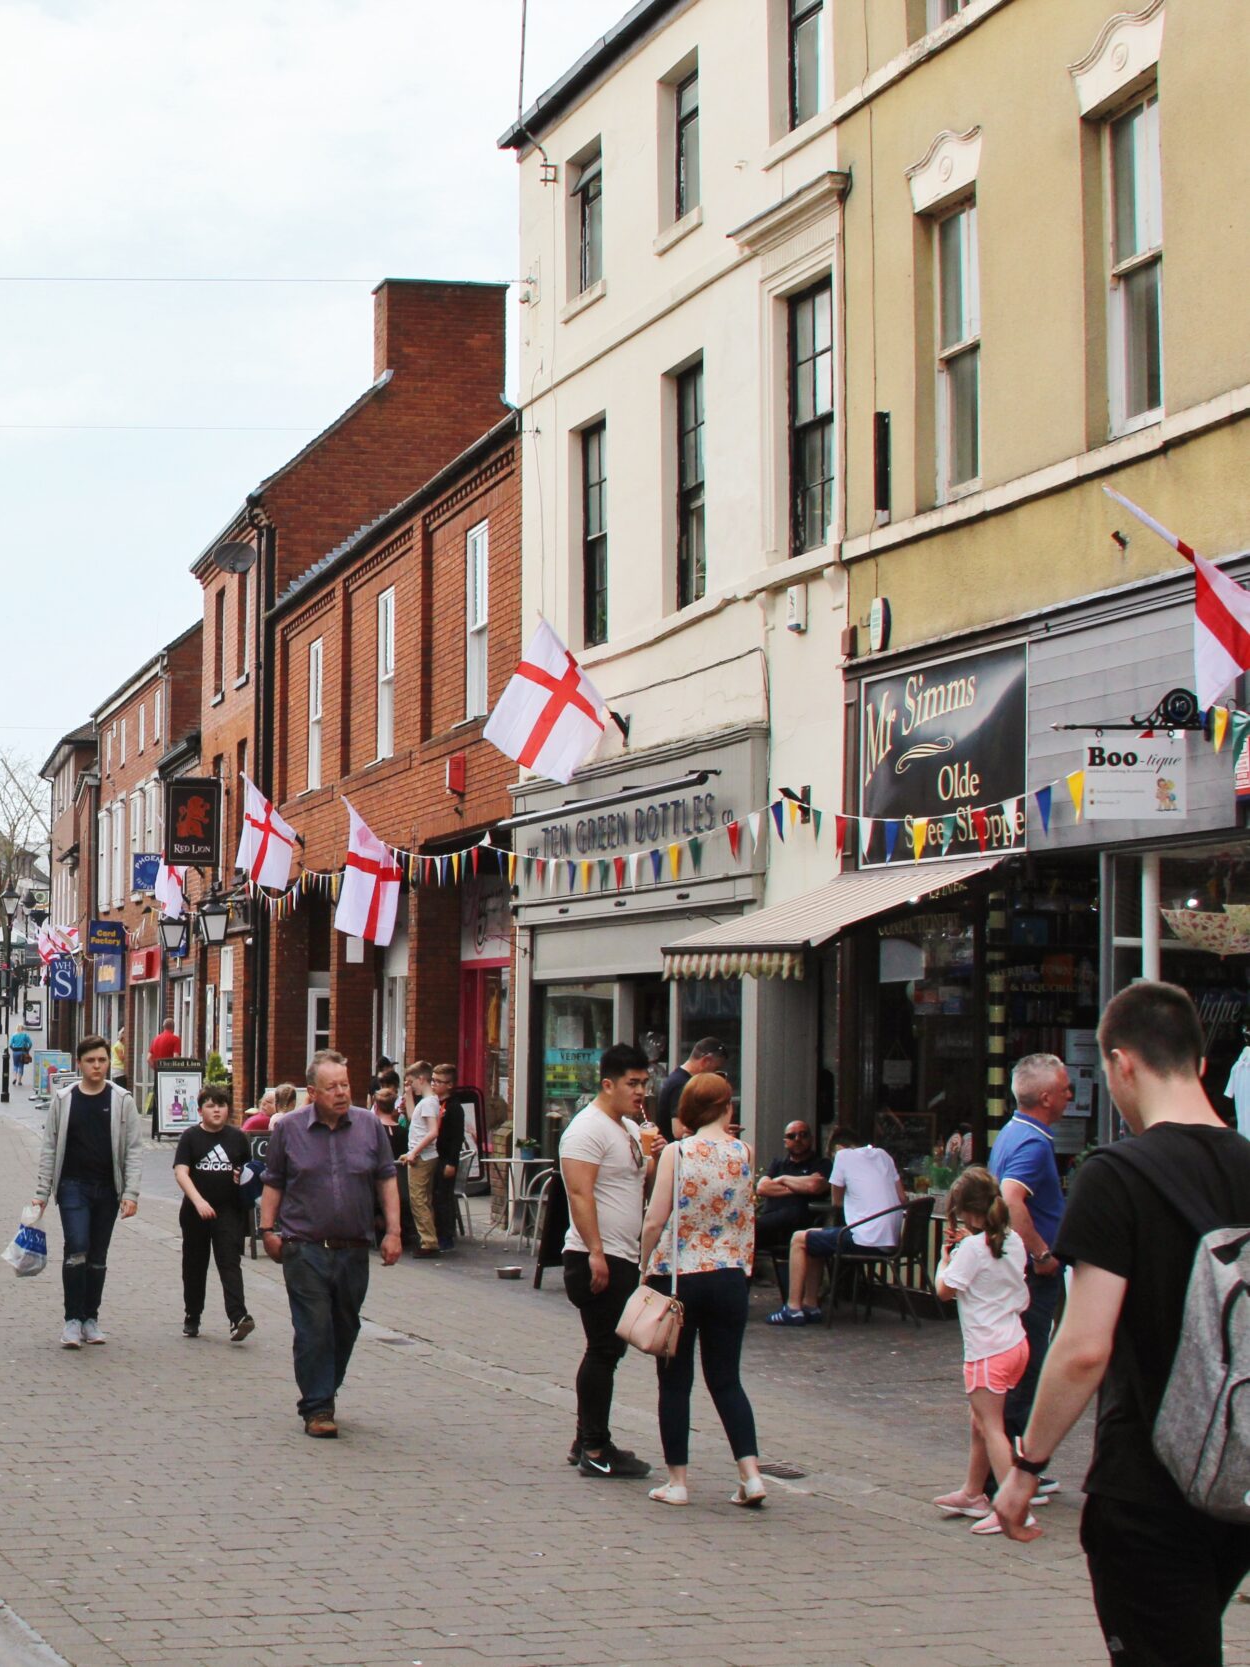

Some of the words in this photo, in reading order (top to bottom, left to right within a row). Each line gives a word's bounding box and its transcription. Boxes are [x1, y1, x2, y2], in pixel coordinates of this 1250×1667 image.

[865, 690, 897, 787] Mr
[901, 674, 976, 736] Simms
[937, 761, 980, 801] Olde
[541, 823, 571, 859] TEN
[575, 812, 629, 854] GREEN
[635, 793, 717, 844] BOTTLES
[904, 814, 954, 848] See
[135, 855, 162, 869] PHOEN
[90, 937, 121, 946] Factory
[96, 929, 116, 937] Card
[54, 961, 72, 970] WH
[54, 969, 72, 997] S
[195, 1161, 233, 1171] adidas
